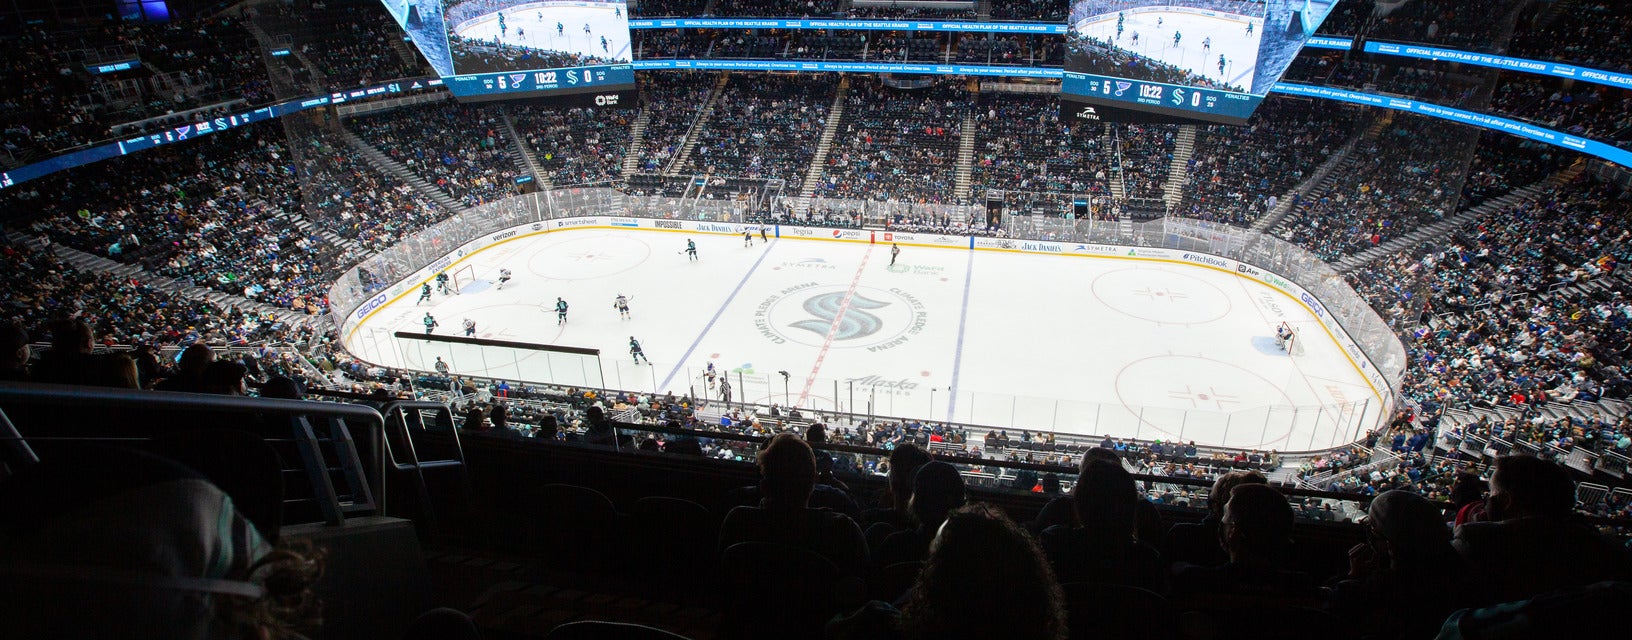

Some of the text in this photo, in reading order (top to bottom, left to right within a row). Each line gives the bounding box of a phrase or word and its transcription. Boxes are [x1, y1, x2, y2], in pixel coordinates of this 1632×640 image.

[1406, 48, 1431, 56] OFFICIAL
[1432, 50, 1456, 58] HEALTH
[1456, 53, 1471, 61] PLAN
[1519, 62, 1546, 70] KRAKEN
[497, 76, 507, 89] 5
[534, 71, 557, 84] 10:22
[584, 70, 592, 83] 0
[1582, 71, 1608, 81] OFFICIAL
[1103, 80, 1111, 94] 5
[1139, 84, 1163, 99] 10:22
[1191, 91, 1201, 107] 0
[1225, 93, 1250, 101] PENALTIES
[1348, 93, 1371, 101] Overtime
[1076, 112, 1100, 121] SYMETRA
[1491, 118, 1504, 127] after
[1505, 122, 1521, 131] period.
[1522, 127, 1545, 137] Overtime
[165, 131, 174, 142] 5
[654, 220, 682, 229] IMPOSSIBLE
[696, 223, 710, 231] JACK
[492, 230, 516, 241] verizon
[793, 228, 813, 236] Tegria
[1021, 242, 1037, 251] JACK
[428, 256, 450, 271] AMERICAN
[1190, 254, 1227, 268] PitchBook
[357, 294, 387, 319] GEICO
[1301, 292, 1324, 318] GEICO
[755, 282, 819, 345] CLIMATE PLEDGE ARENA
[867, 287, 928, 353] CLIMATE PLEDGE ARENA
[844, 375, 919, 390] Alaska
